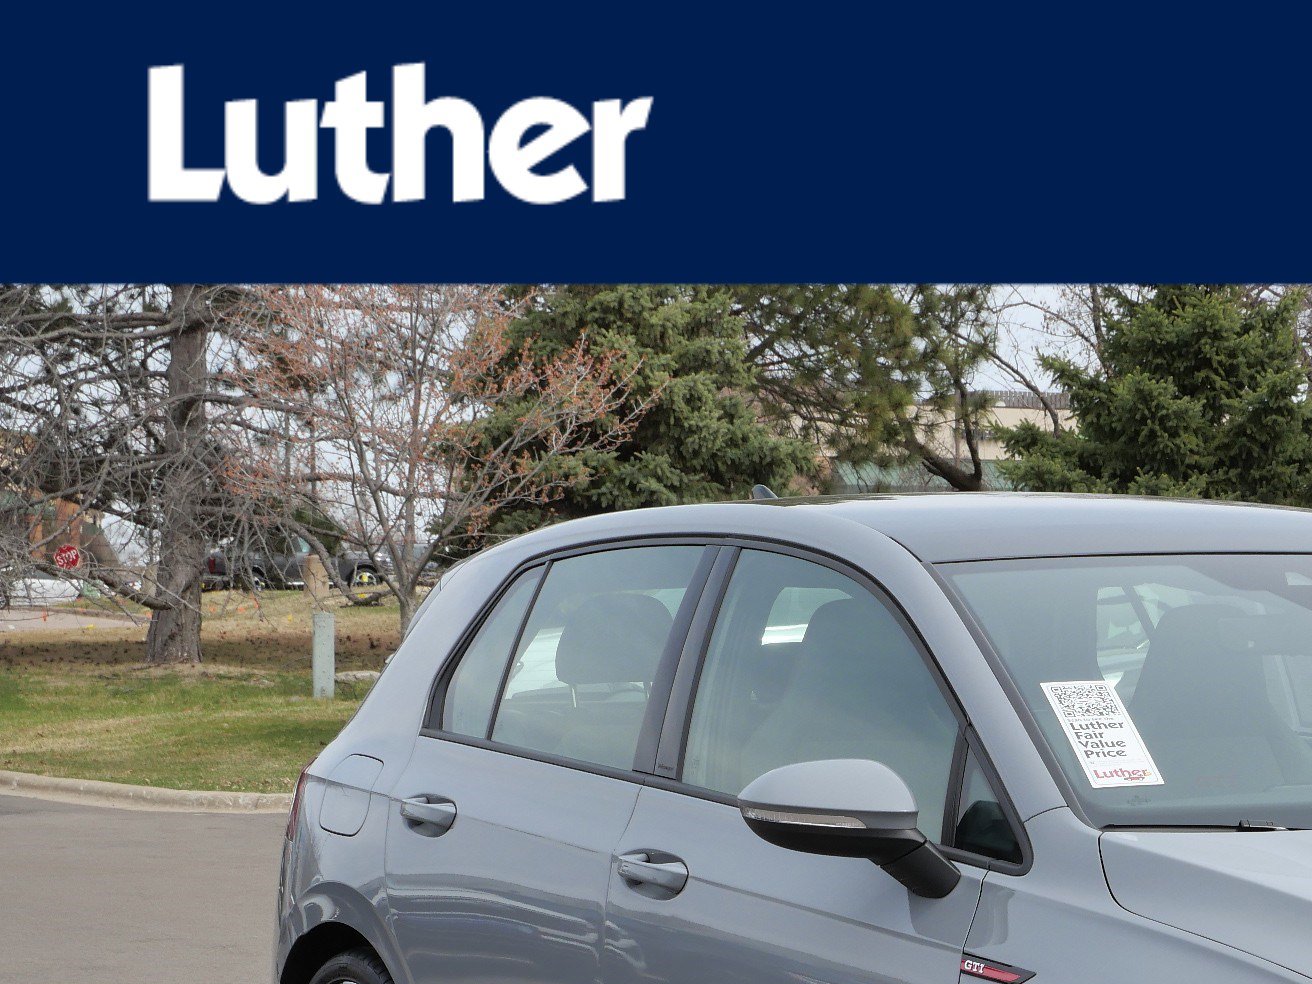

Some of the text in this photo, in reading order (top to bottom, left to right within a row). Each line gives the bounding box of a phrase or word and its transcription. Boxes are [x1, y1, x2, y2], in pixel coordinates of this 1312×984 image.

[56, 550, 77, 565] STOP
[1070, 721, 1124, 731] Luther
[1074, 730, 1104, 740] Fair
[1078, 740, 1126, 748] Value
[1084, 749, 1127, 758] Price
[1093, 768, 1147, 778] Luther
[964, 960, 986, 973] GTI
